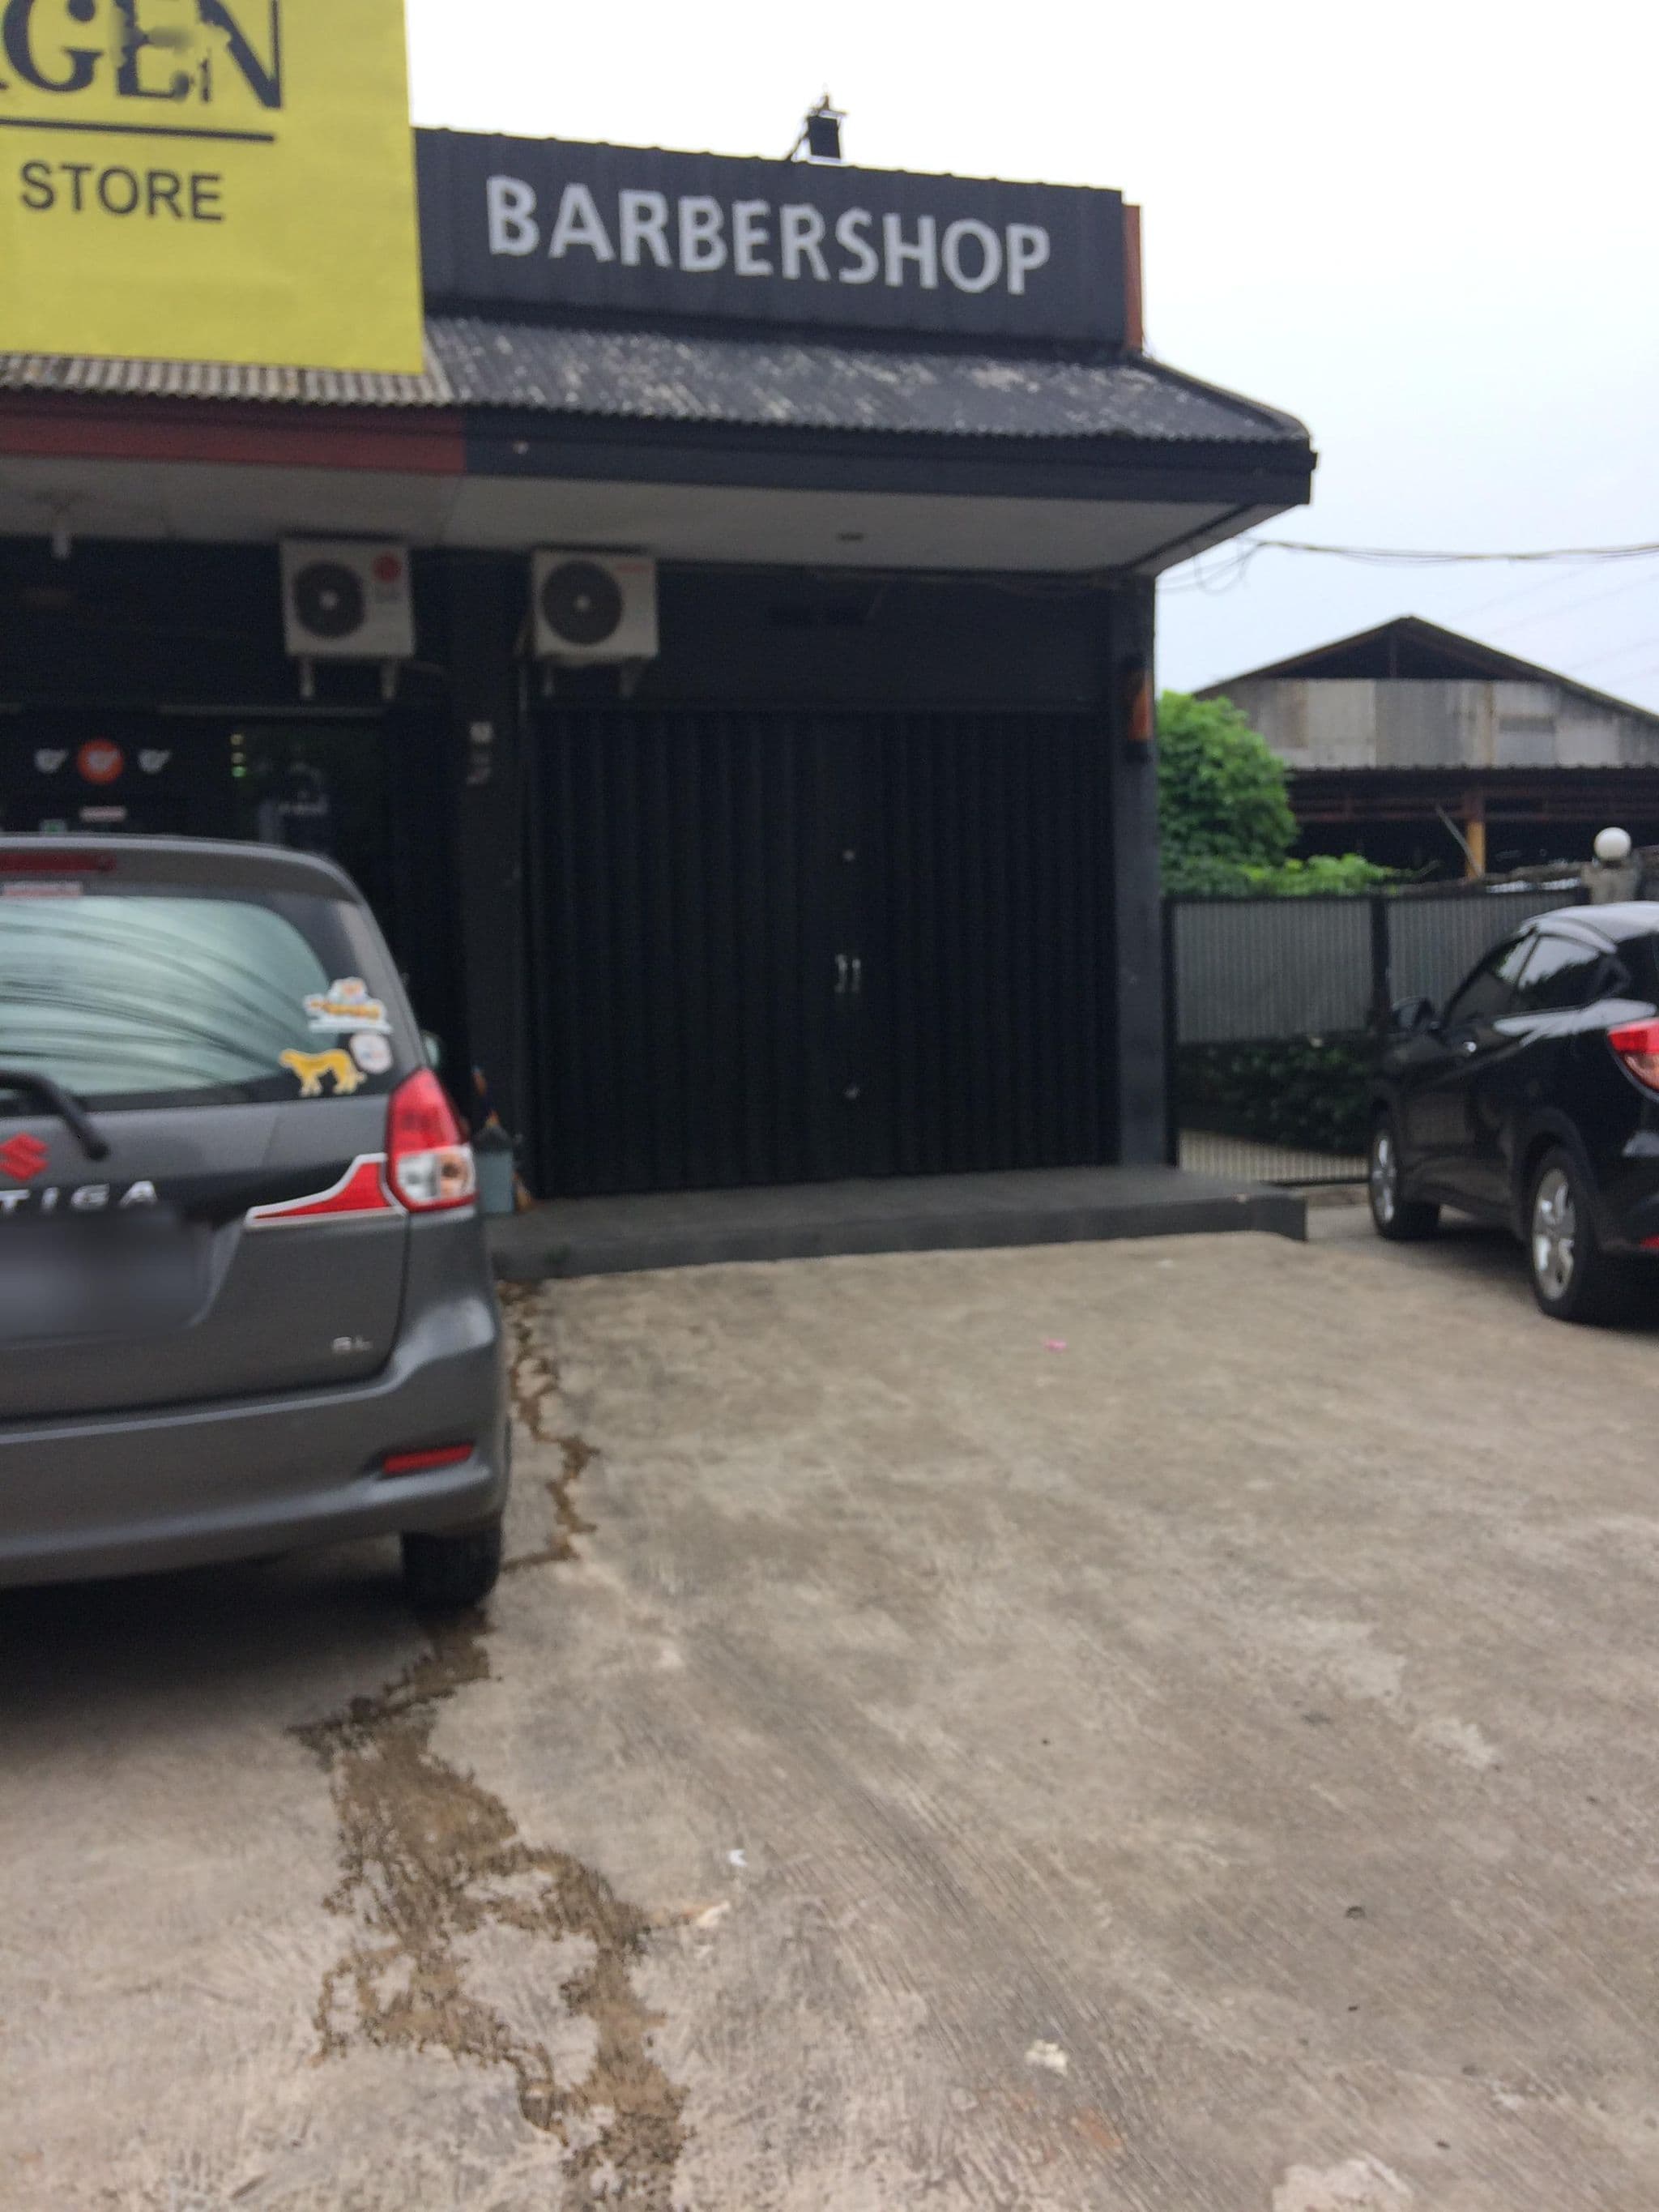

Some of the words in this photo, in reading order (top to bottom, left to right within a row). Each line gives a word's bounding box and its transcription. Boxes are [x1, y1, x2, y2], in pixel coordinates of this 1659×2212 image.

[0, 0, 282, 109] GEN
[21, 160, 224, 221] STORE
[486, 175, 1051, 295] BARBERSHOP
